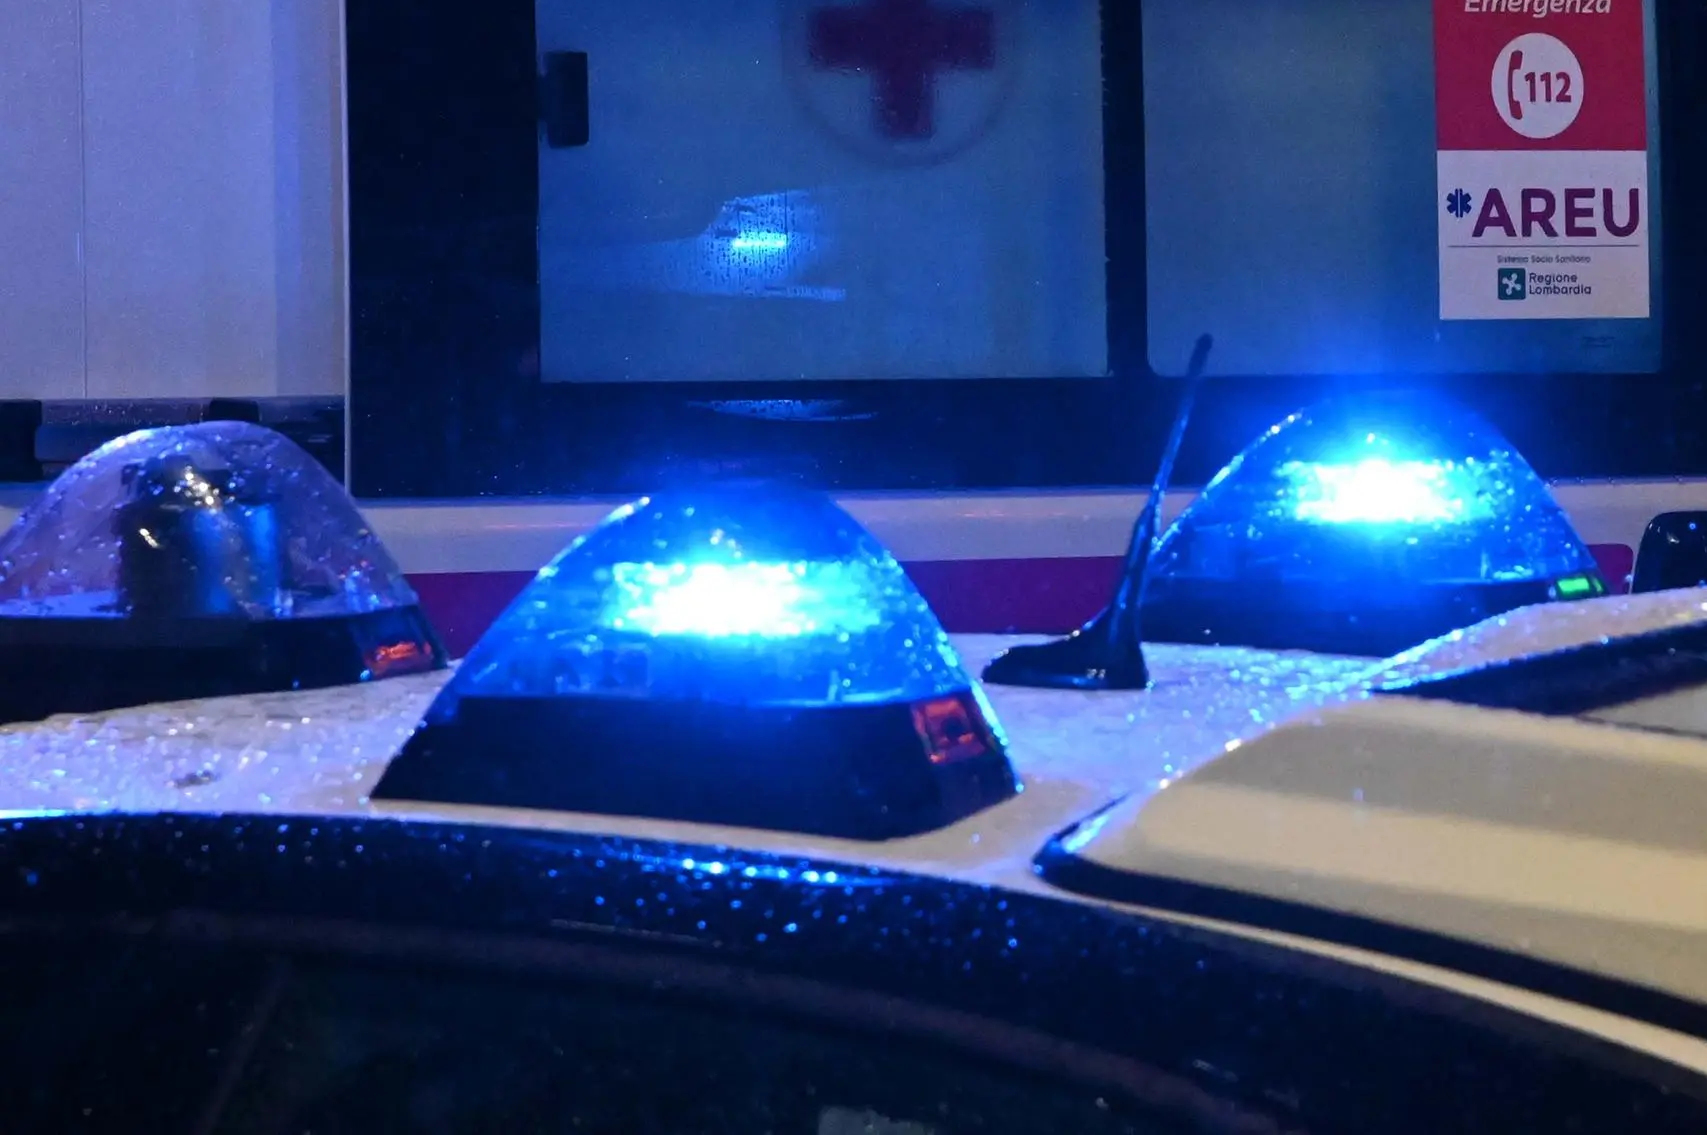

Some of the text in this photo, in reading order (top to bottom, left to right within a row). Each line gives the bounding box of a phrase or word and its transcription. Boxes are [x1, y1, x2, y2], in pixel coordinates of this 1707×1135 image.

[1524, 71, 1572, 103] 112
[1471, 187, 1640, 238] AREU
[1529, 272, 1578, 285] Regione
[1529, 284, 1592, 295] Lombardia
